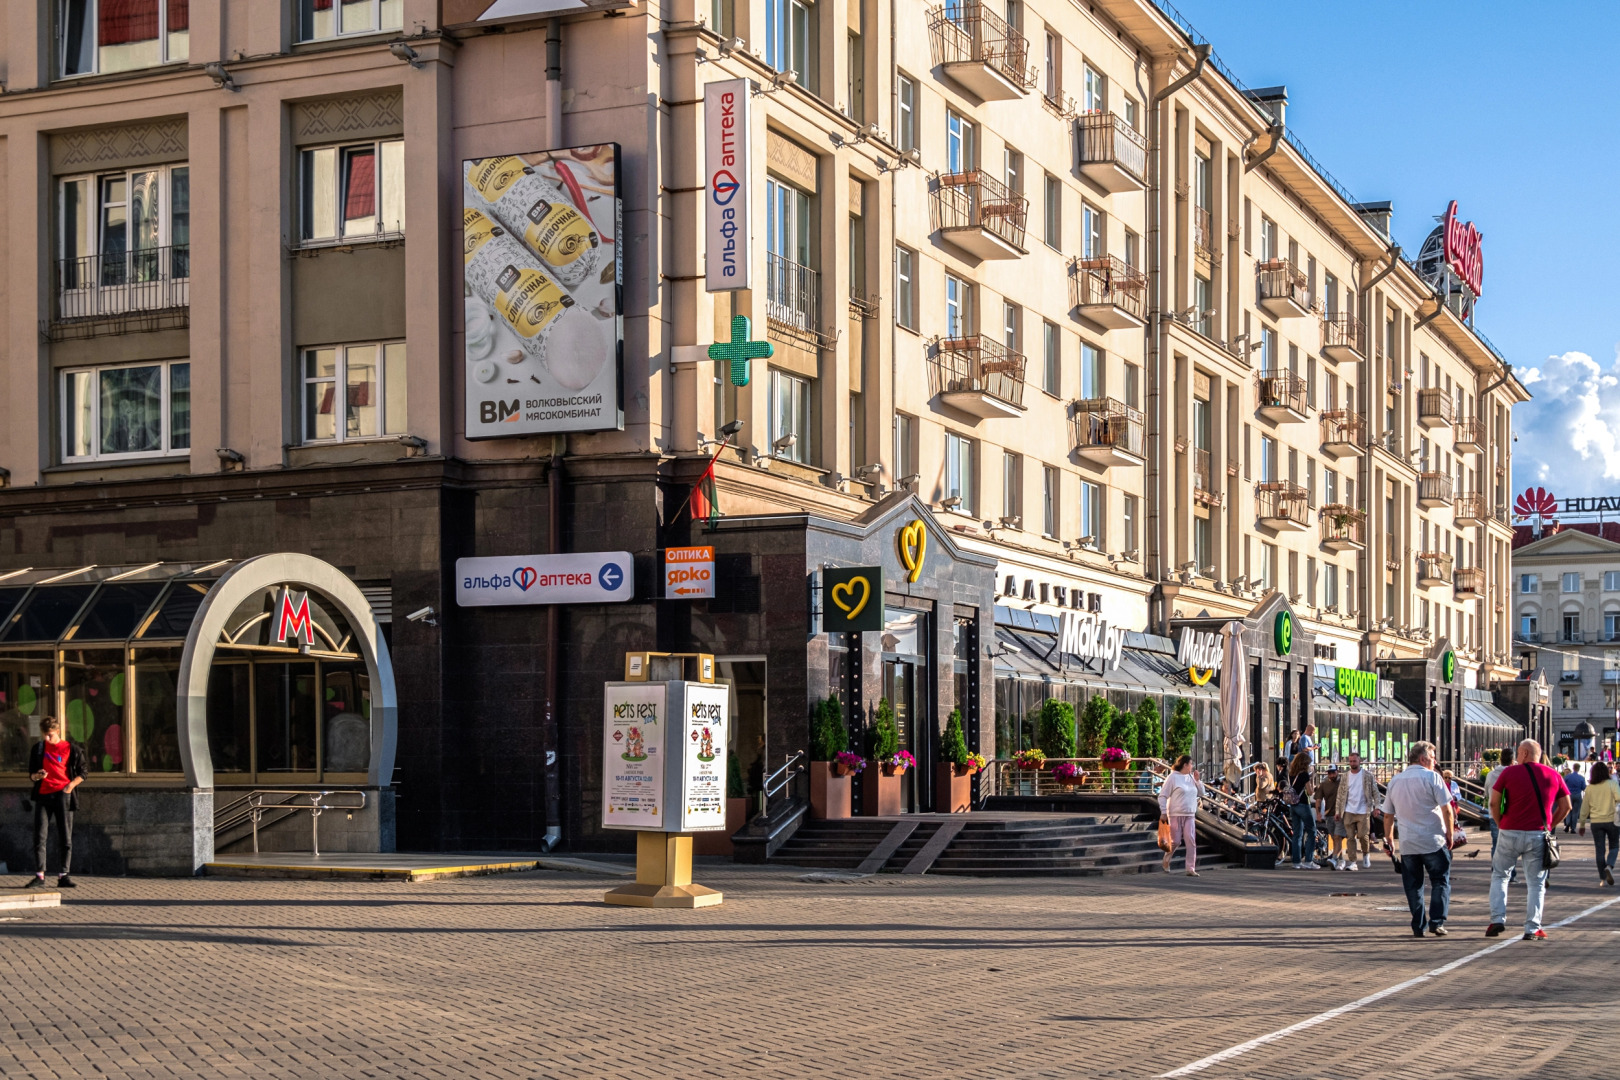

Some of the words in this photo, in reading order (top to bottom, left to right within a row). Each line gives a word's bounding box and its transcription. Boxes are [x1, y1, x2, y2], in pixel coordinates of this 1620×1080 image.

[721, 92, 735, 167] аптека
[537, 209, 578, 254] СЛИВОЧНАЯ
[719, 207, 738, 277] альфа
[507, 275, 548, 323] СЛИВОЧНАЯ
[525, 393, 602, 409] ВОЛКОВЫССКИЙ
[525, 407, 602, 422] МЯСОКОМБИНАТ
[666, 549, 711, 561] ОПТИКА
[463, 573, 511, 591] альфа
[539, 571, 592, 587] аптека
[994, 571, 1103, 613] АЛІЧНЫ
[1060, 612, 1125, 672] Mak.by
[1337, 667, 1378, 707] евроопт
